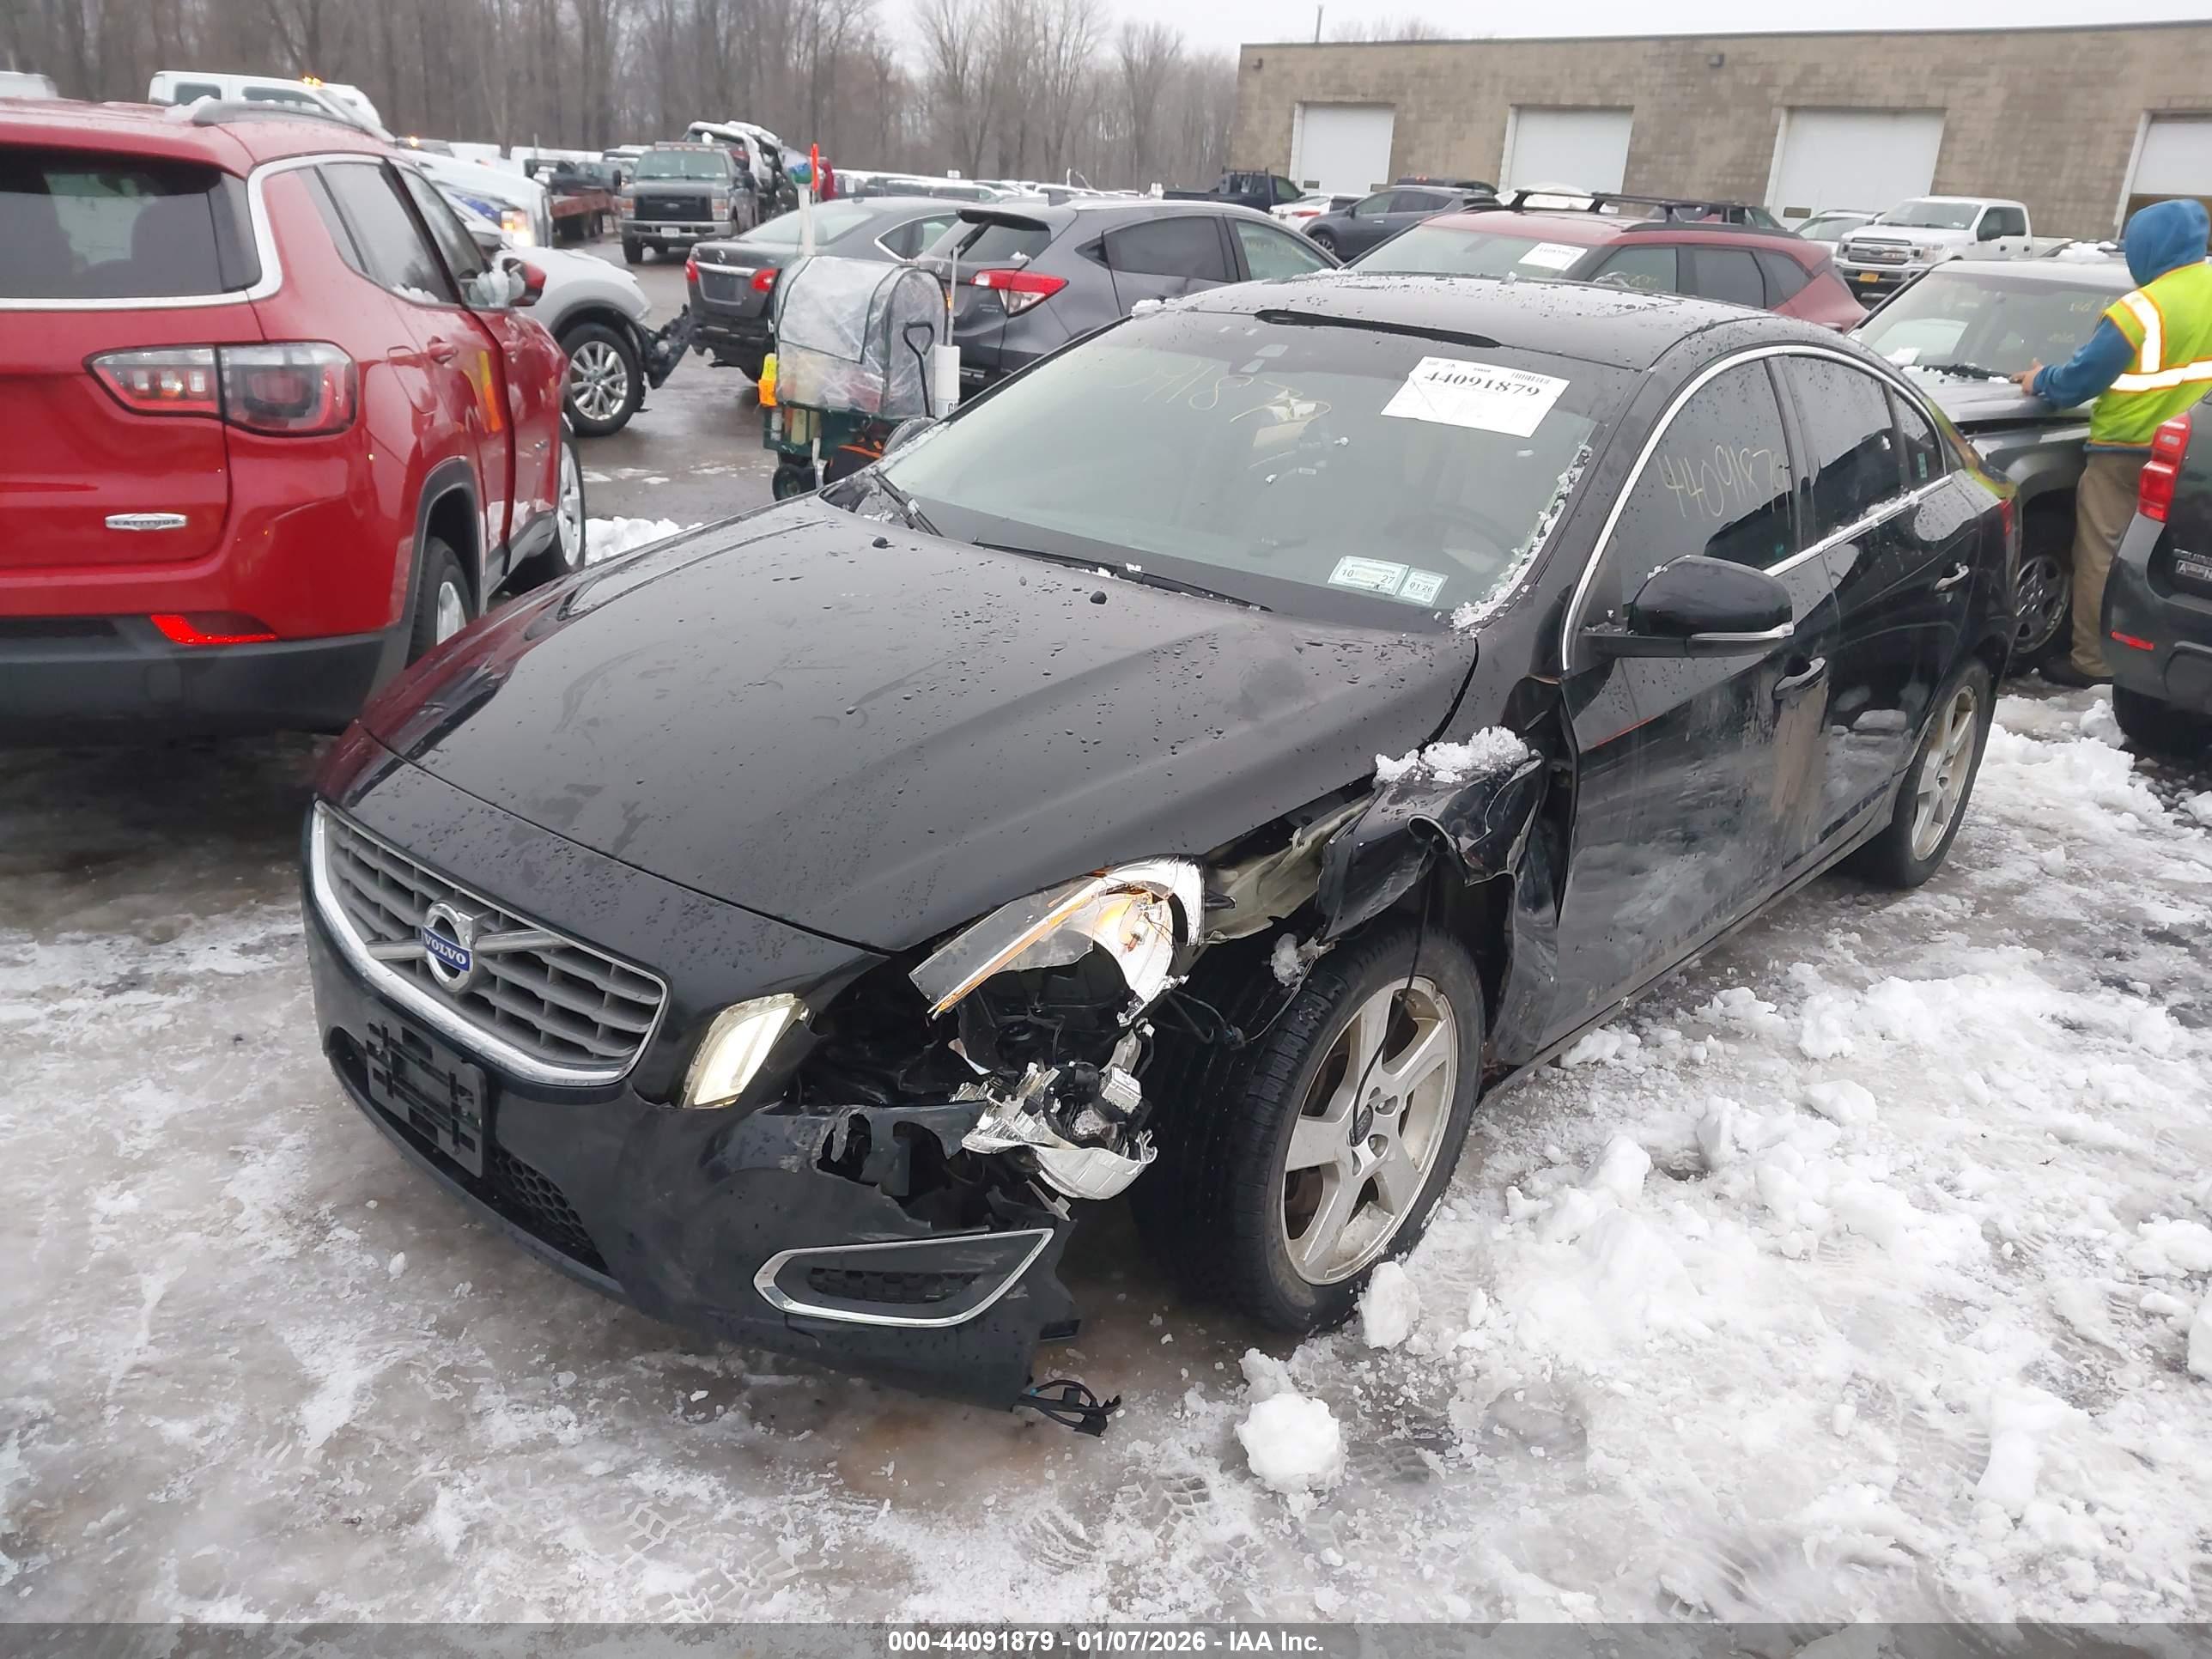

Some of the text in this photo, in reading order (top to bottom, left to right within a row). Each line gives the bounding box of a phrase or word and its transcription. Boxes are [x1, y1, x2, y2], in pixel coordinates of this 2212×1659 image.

[1424, 370, 1540, 398] 44091879
[1380, 574, 1395, 585] 27
[423, 933, 466, 964] VOLVO
